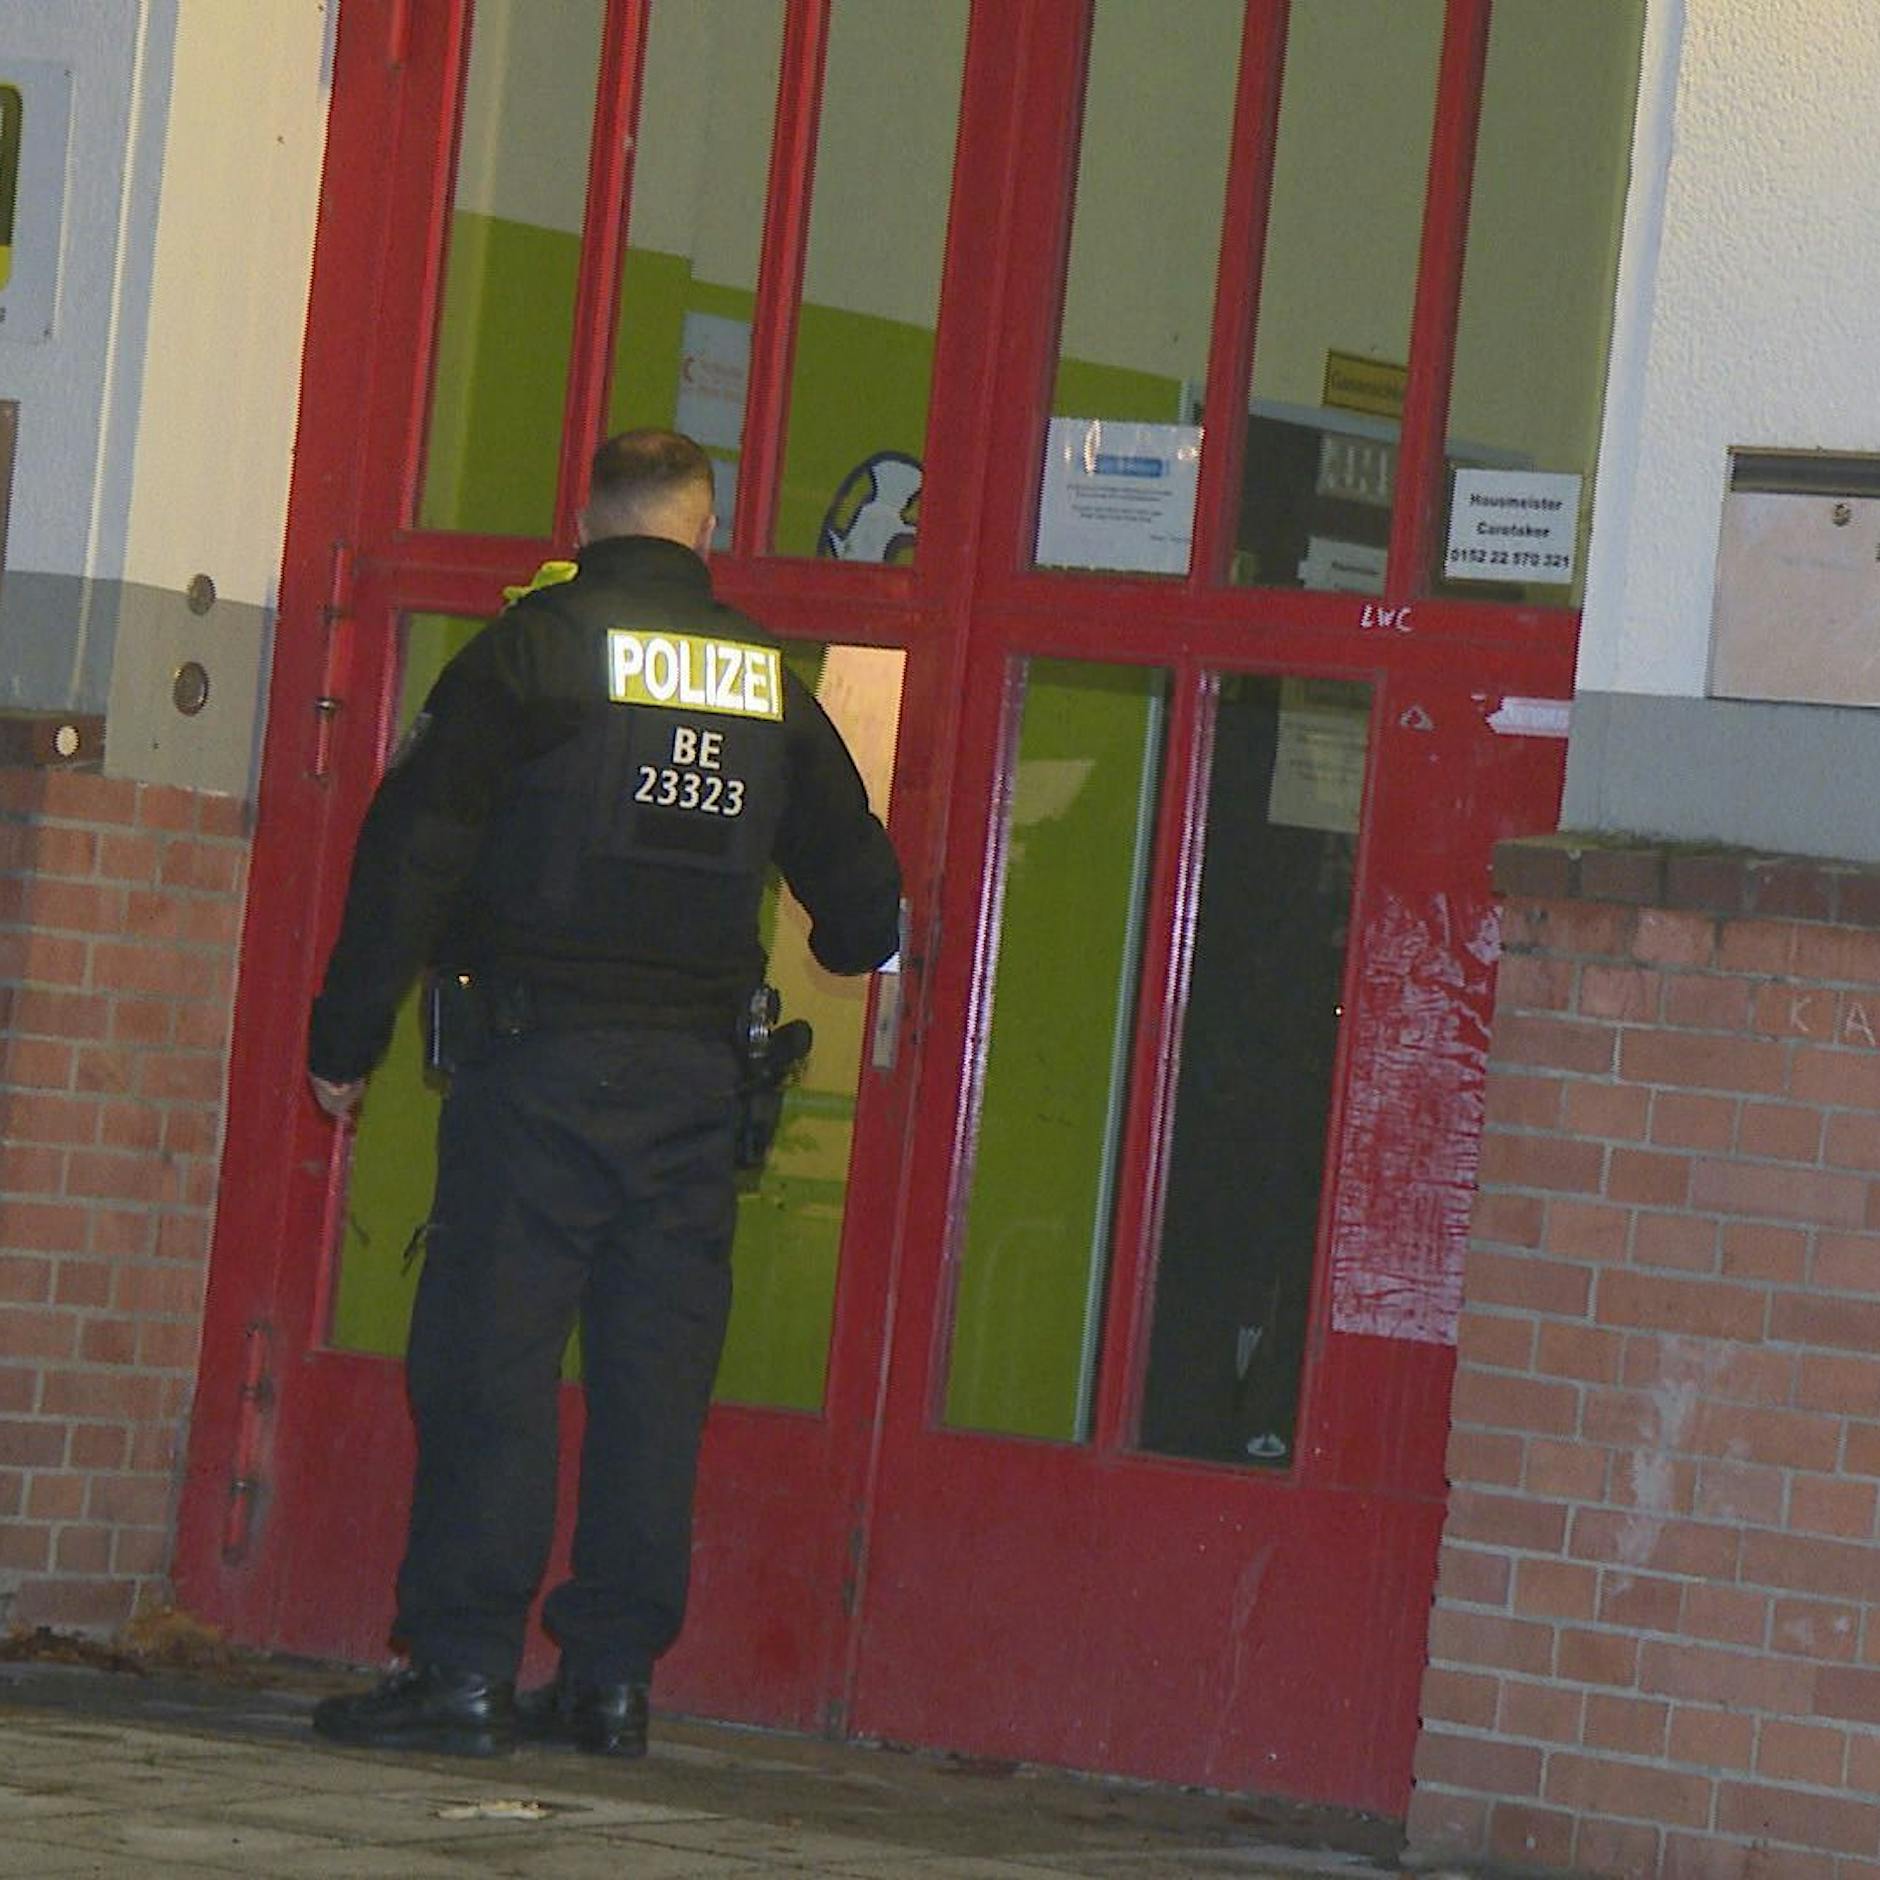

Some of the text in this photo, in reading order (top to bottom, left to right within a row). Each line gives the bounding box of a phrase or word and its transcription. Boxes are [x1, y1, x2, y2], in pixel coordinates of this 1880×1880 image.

[612, 632, 779, 715] POLIZEI
[672, 725, 723, 770] BE
[634, 765, 746, 816] 23323
